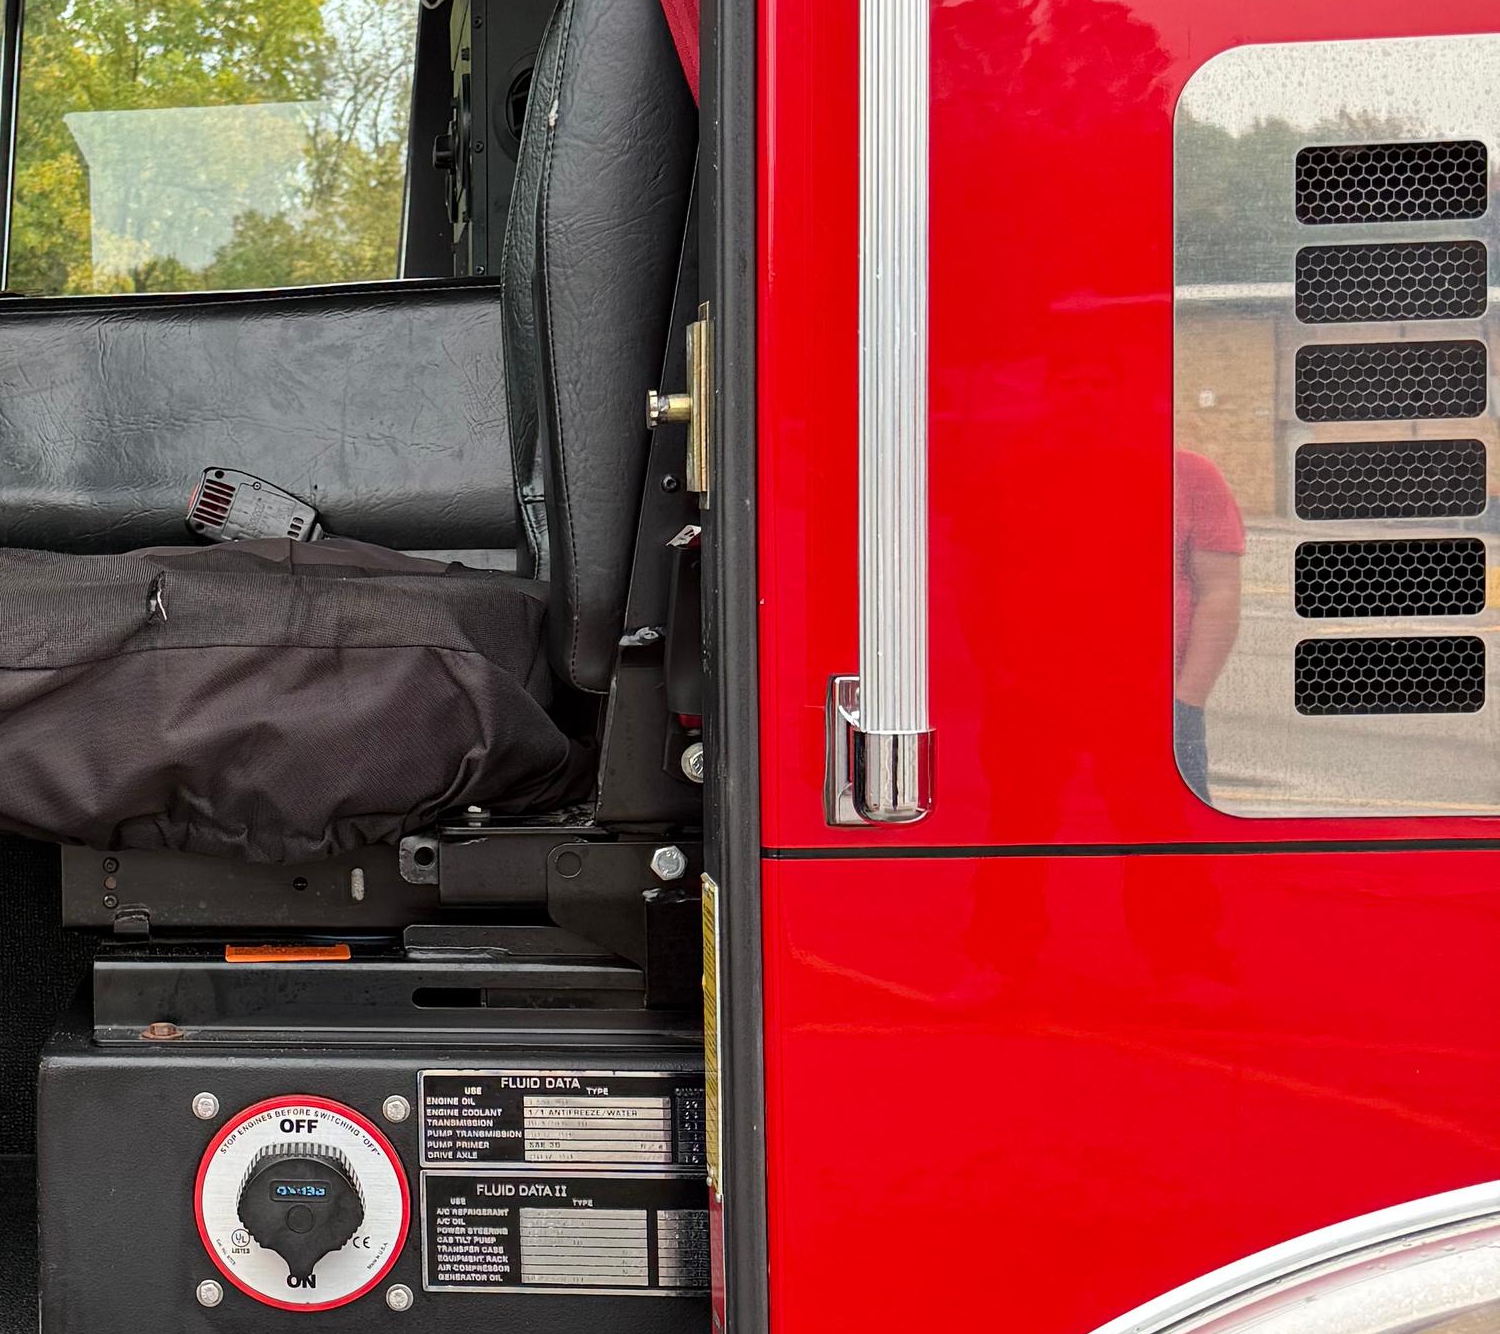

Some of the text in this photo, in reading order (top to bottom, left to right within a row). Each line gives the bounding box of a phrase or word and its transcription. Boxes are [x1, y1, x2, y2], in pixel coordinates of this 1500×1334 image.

[501, 1078, 580, 1088] FLUID DATA
[465, 1087, 482, 1095] USE
[586, 1087, 609, 1095] TYPE
[426, 1097, 475, 1105] ENGINE OIL
[279, 1119, 318, 1134] OFF
[427, 1119, 493, 1127] TRANSMISSION
[220, 1135, 237, 1154] STOP
[238, 1112, 272, 1135] ENGINES
[275, 1109, 311, 1117] BEFORE
[314, 1110, 360, 1136] SWITCHING
[456, 1130, 522, 1138] TRANSMISSION
[477, 1184, 567, 1197] FLUID DATA II
[450, 1197, 466, 1205] USE
[572, 1198, 593, 1207] TYPE
[352, 1236, 370, 1249] CE
[287, 1274, 316, 1289] ON
